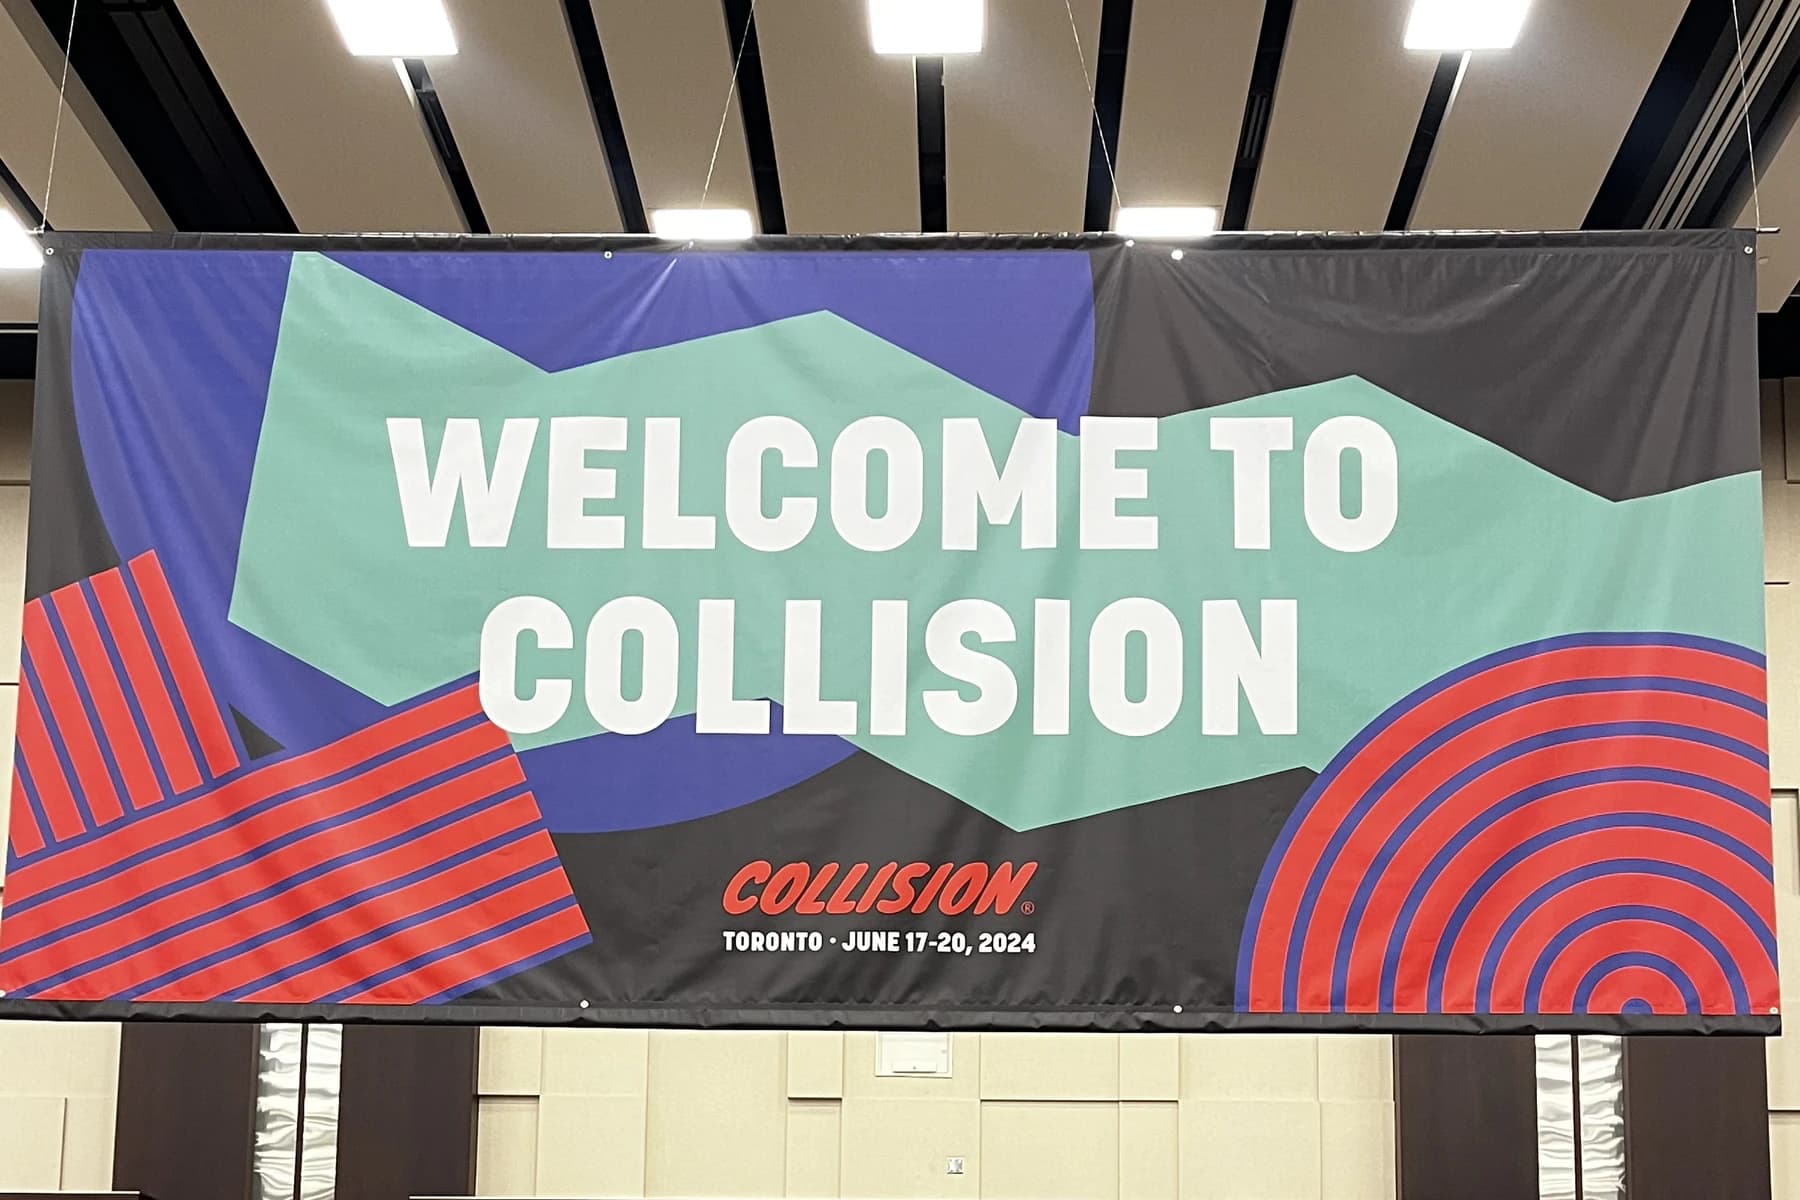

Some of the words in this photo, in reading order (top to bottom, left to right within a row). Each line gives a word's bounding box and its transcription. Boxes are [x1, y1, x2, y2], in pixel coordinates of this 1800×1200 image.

[387, 416, 1160, 552] WELCOME
[1210, 416, 1399, 553] TO
[479, 596, 1299, 738] COLLISION
[723, 931, 823, 952] TORONTO
[841, 932, 900, 952] JUNE
[905, 932, 973, 955] 17-20,
[978, 932, 1036, 953] 2024
